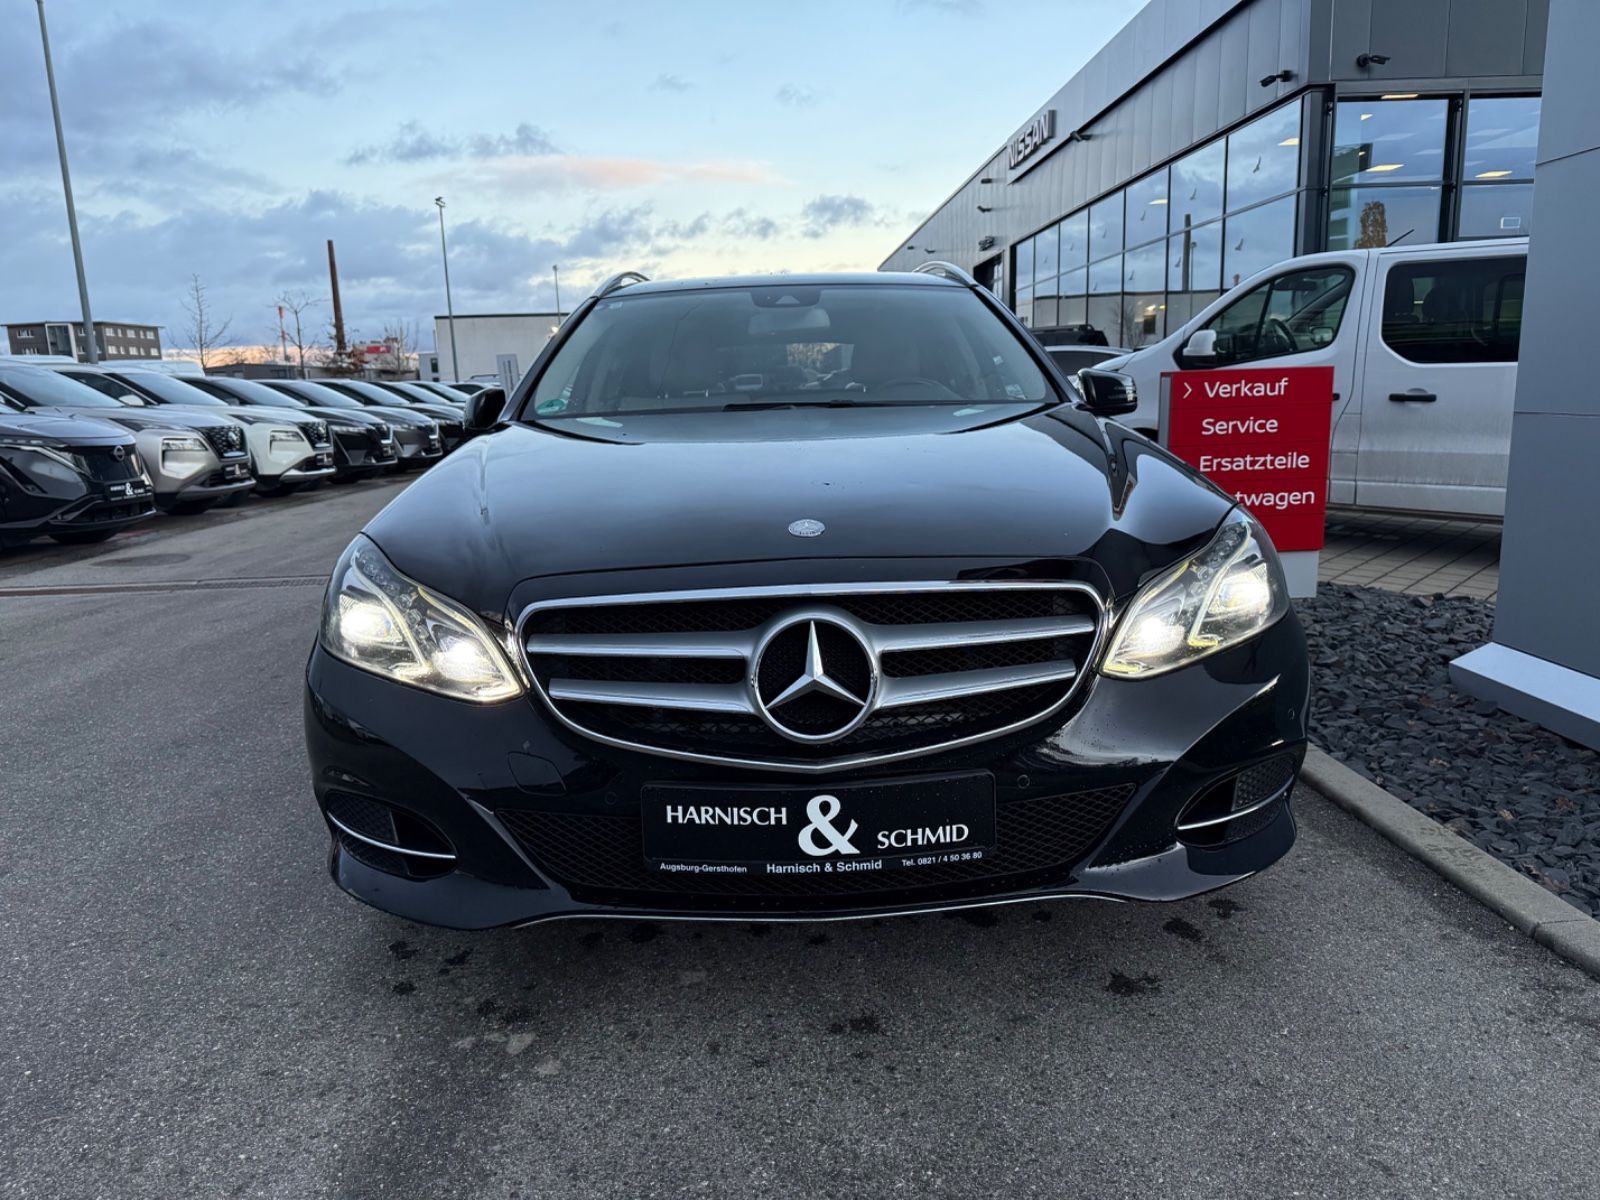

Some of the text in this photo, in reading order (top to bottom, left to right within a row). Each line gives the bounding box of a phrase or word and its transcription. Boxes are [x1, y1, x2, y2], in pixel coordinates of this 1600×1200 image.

[1008, 111, 1053, 169] NISSAN
[1204, 377, 1289, 398] Verkauf
[1201, 416, 1279, 436] Service
[1200, 452, 1310, 473] Ersatzteile
[1234, 490, 1316, 510] twagen
[666, 794, 969, 857] HARNISCH & SCHMID
[660, 862, 748, 874] Augsburg-Gersthofen
[766, 863, 821, 874] Harnisch
[824, 862, 834, 873] &
[836, 859, 883, 873] Schmid
[902, 858, 916, 867] Tel.
[917, 856, 936, 866] 0821
[942, 854, 948, 862] 4
[949, 853, 960, 862] 50
[960, 851, 971, 861] 36
[971, 850, 983, 859] 80
